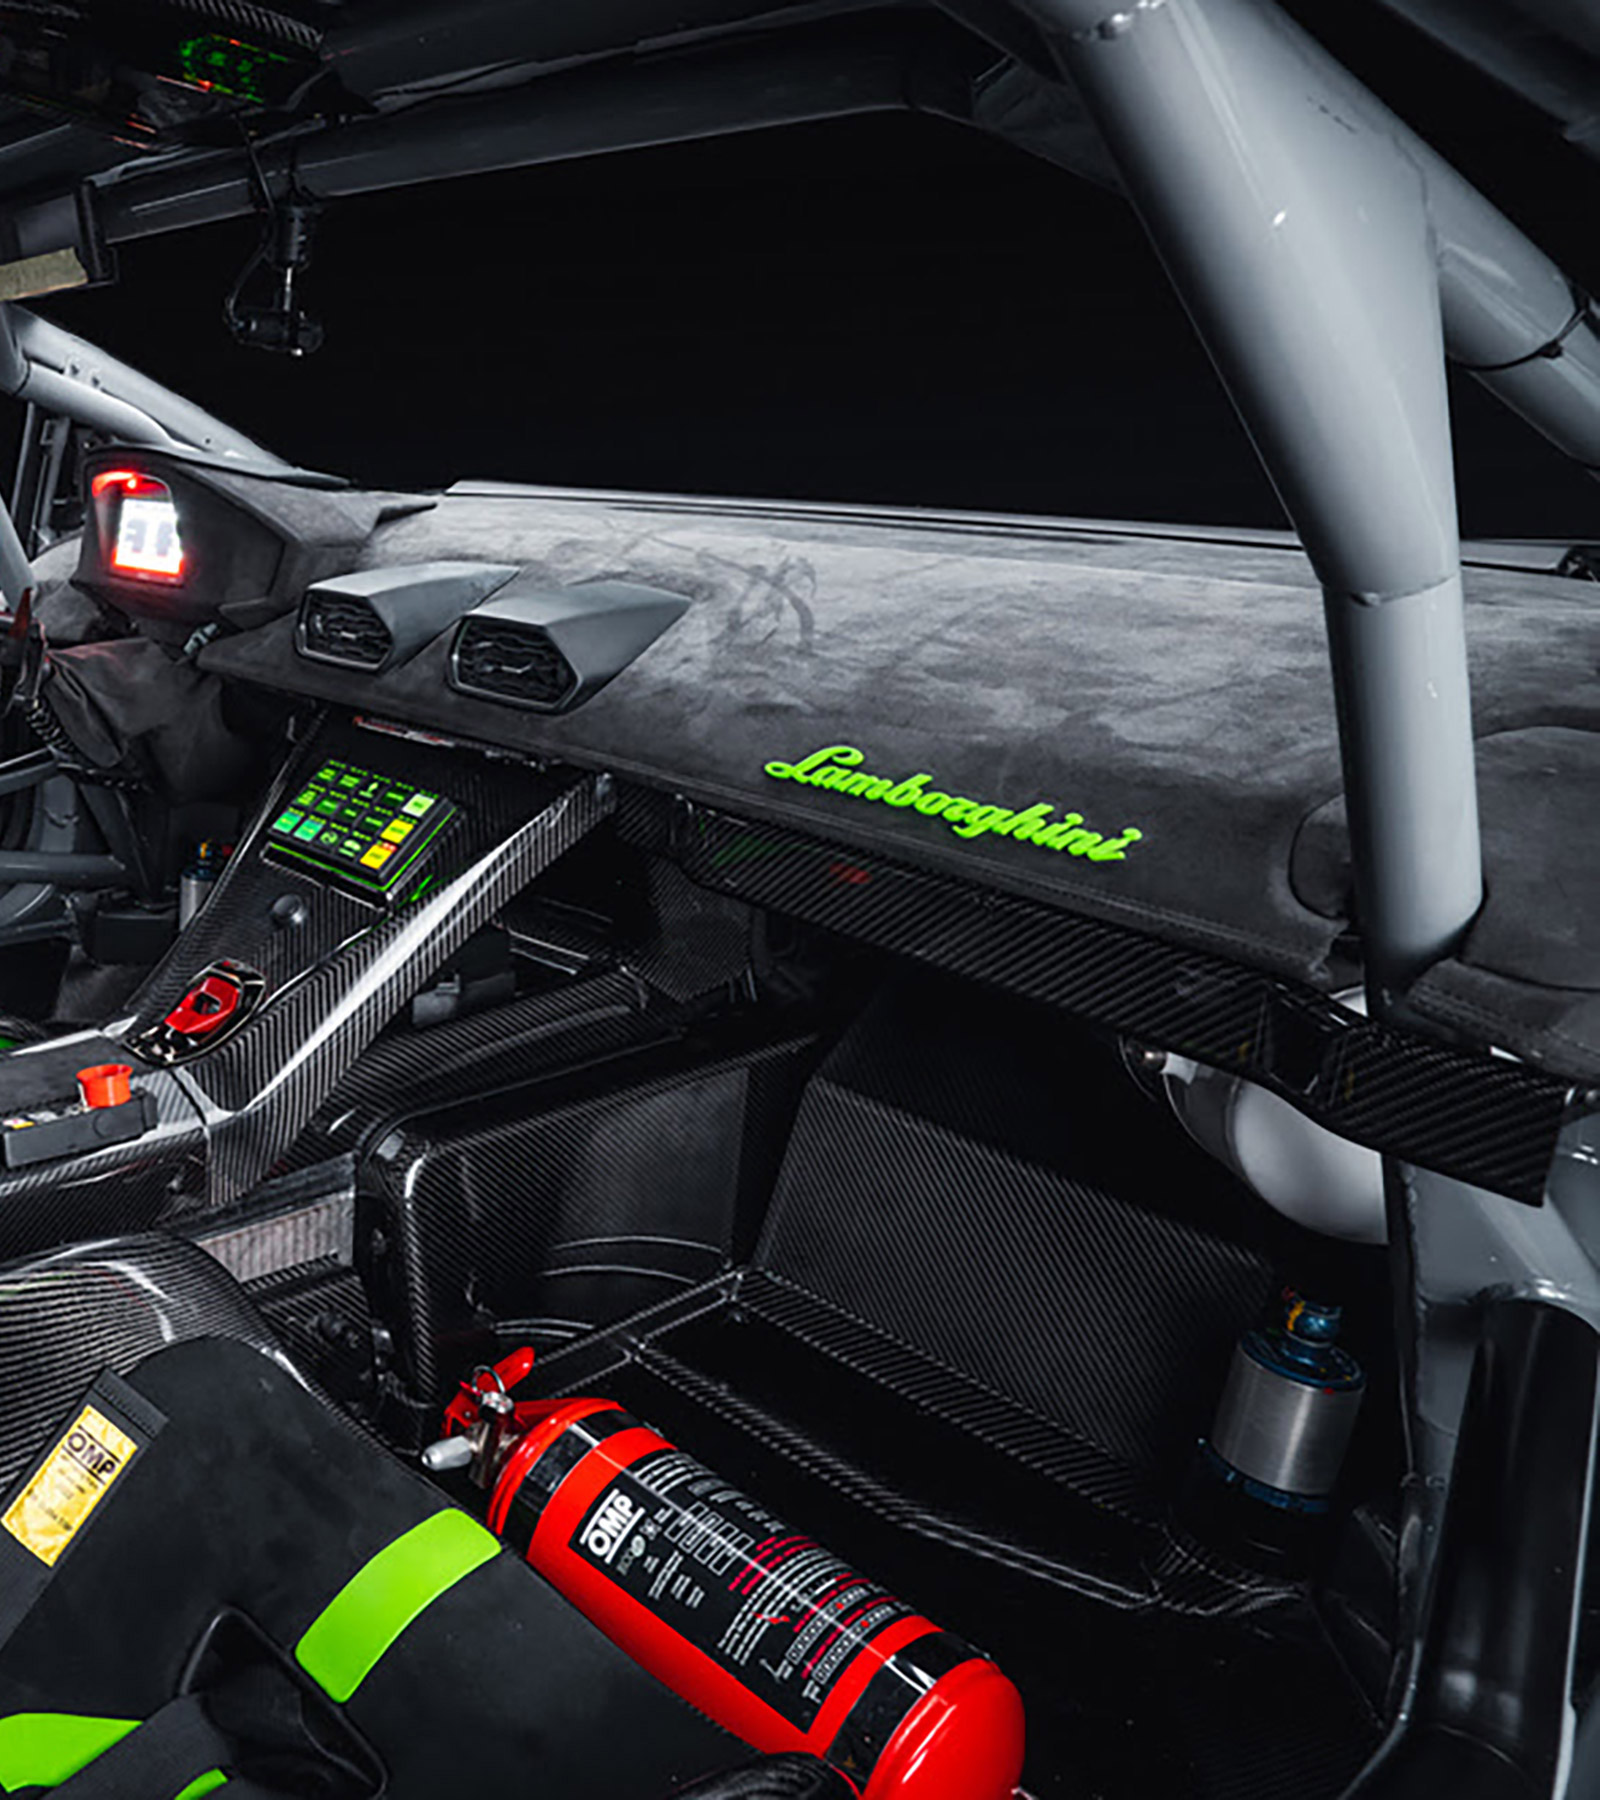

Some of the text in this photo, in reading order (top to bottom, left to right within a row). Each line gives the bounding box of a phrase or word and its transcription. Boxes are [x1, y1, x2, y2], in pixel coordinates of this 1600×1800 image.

[764, 745, 1142, 861] Lamborghini
[67, 1432, 116, 1475] OMP
[588, 1494, 633, 1556] OMP
